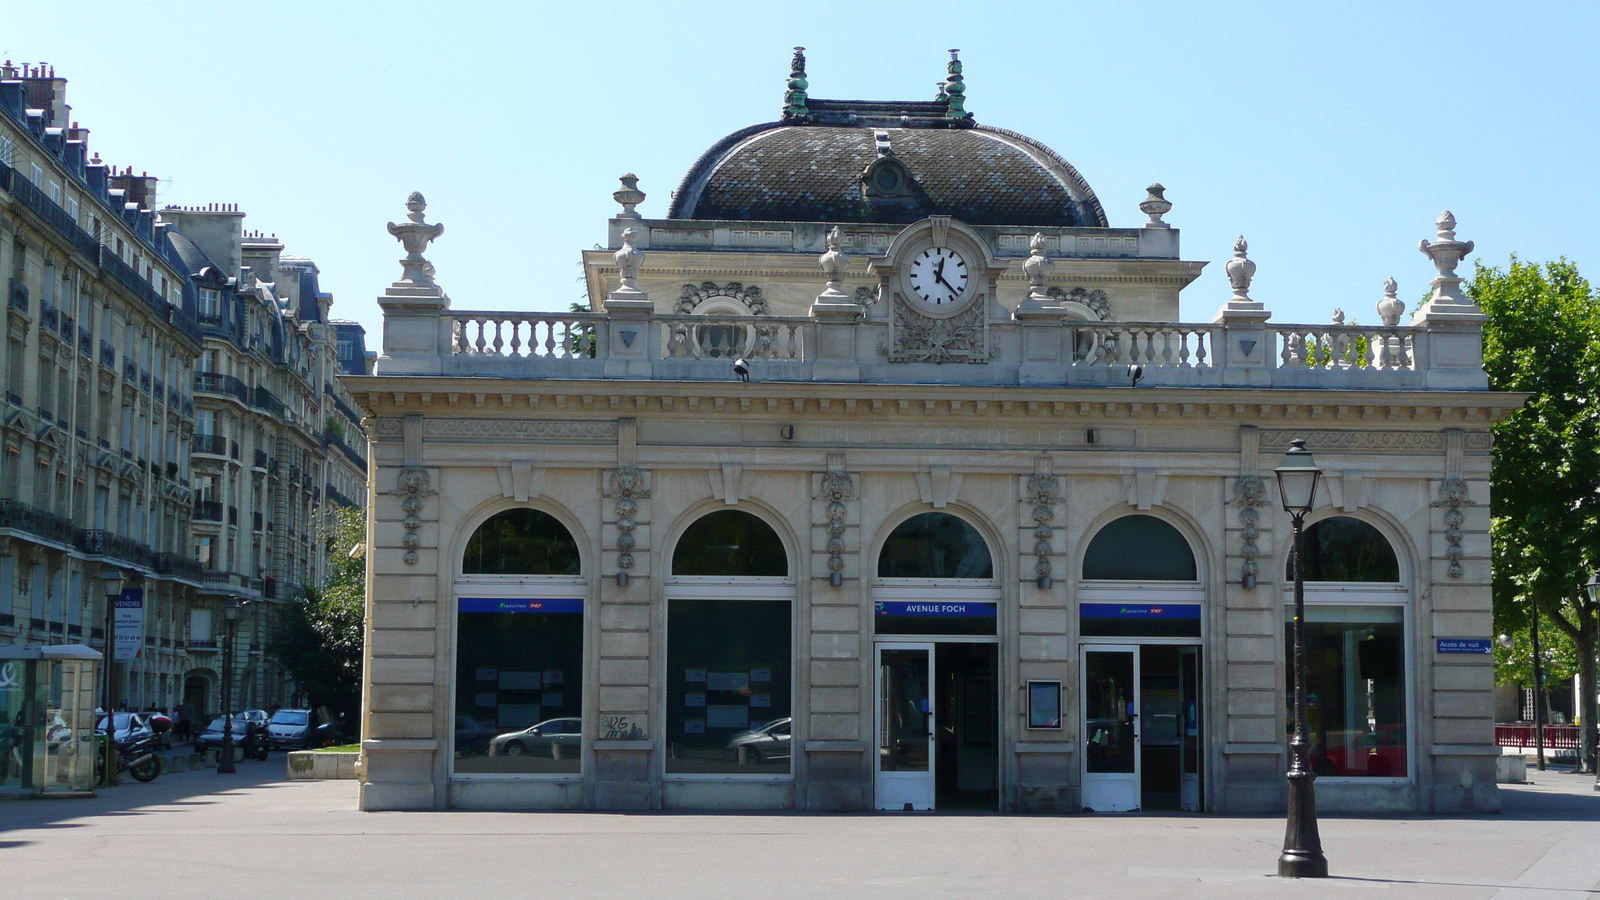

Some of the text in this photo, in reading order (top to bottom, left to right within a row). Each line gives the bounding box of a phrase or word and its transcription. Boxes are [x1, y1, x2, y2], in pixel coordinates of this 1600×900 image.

[920, 428, 969, 444] FER
[987, 428, 1020, 444] DE
[906, 605, 966, 613] AVENUE FOCH
